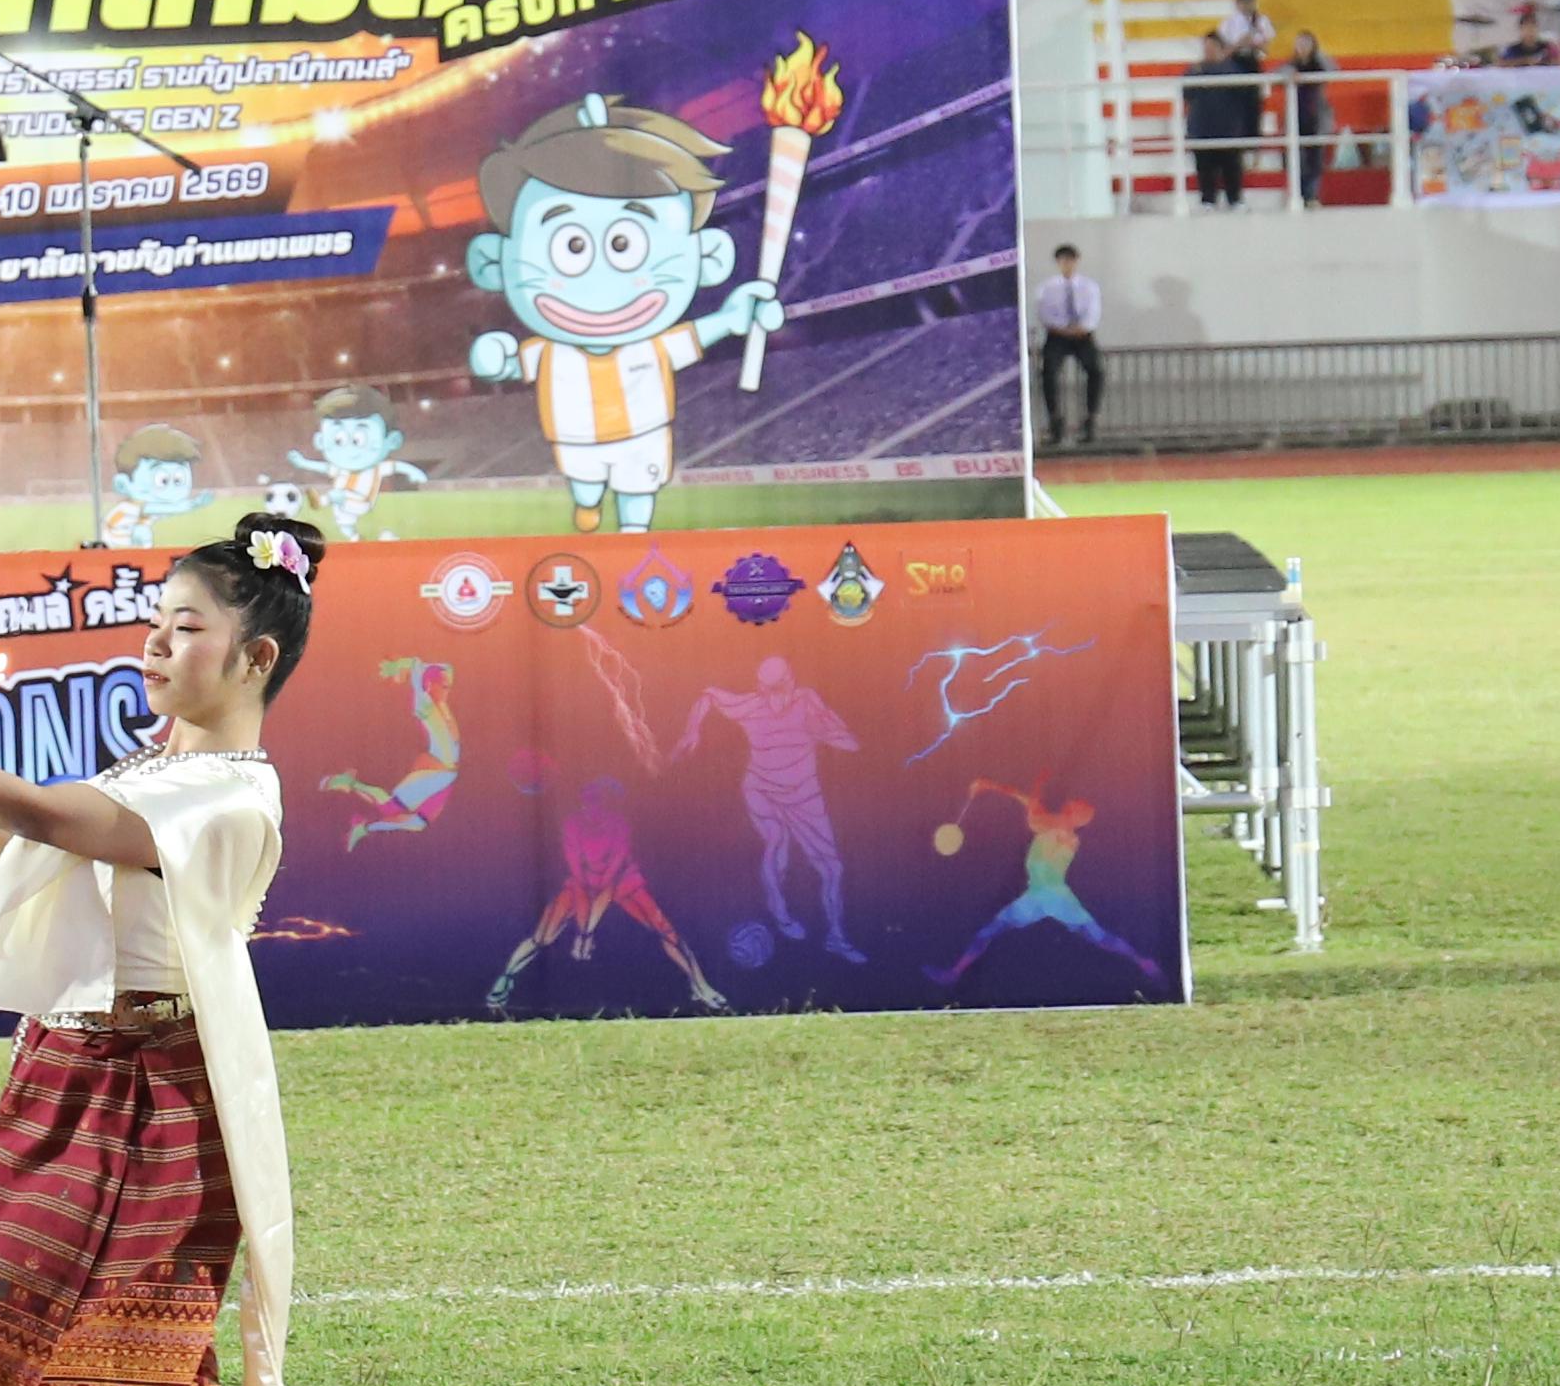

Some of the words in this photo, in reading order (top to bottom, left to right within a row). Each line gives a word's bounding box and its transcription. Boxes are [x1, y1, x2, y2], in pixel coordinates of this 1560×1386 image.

[150, 109, 216, 131] GEN
[218, 104, 242, 130] Z
[46, 174, 174, 213] มกราคม
[182, 162, 268, 203] 2569
[647, 463, 660, 482] 9
[773, 464, 871, 481] BUSINESS
